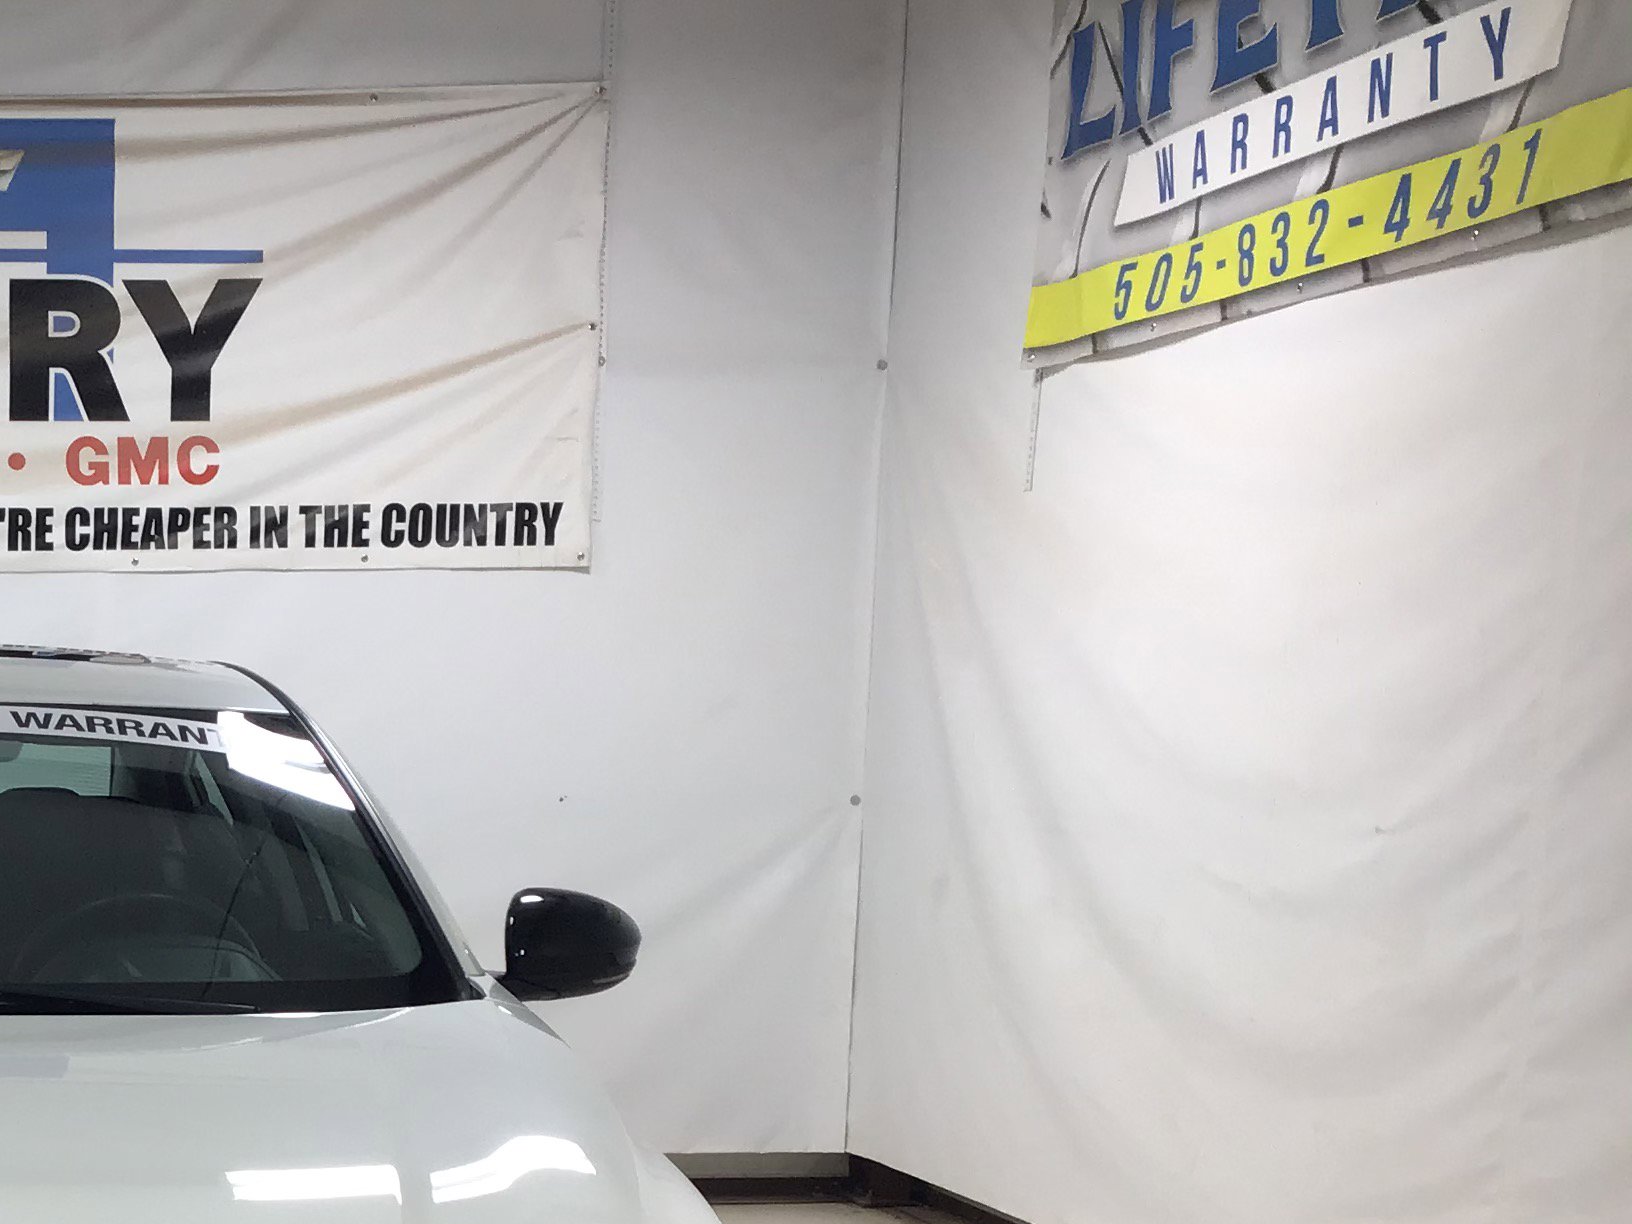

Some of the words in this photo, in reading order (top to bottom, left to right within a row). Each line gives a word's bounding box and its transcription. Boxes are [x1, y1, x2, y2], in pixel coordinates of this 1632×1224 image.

[1061, 0, 1424, 159] LIFE
[1156, 7, 1512, 203] WARRANTY
[1114, 129, 1543, 320] 505-832-4431
[65, 435, 220, 486] GMC
[64, 506, 238, 551] CHEAPER
[248, 505, 289, 549] IN
[299, 504, 371, 549] THE
[380, 502, 564, 548] COUNTRY
[9, 709, 218, 746] WARRAN
